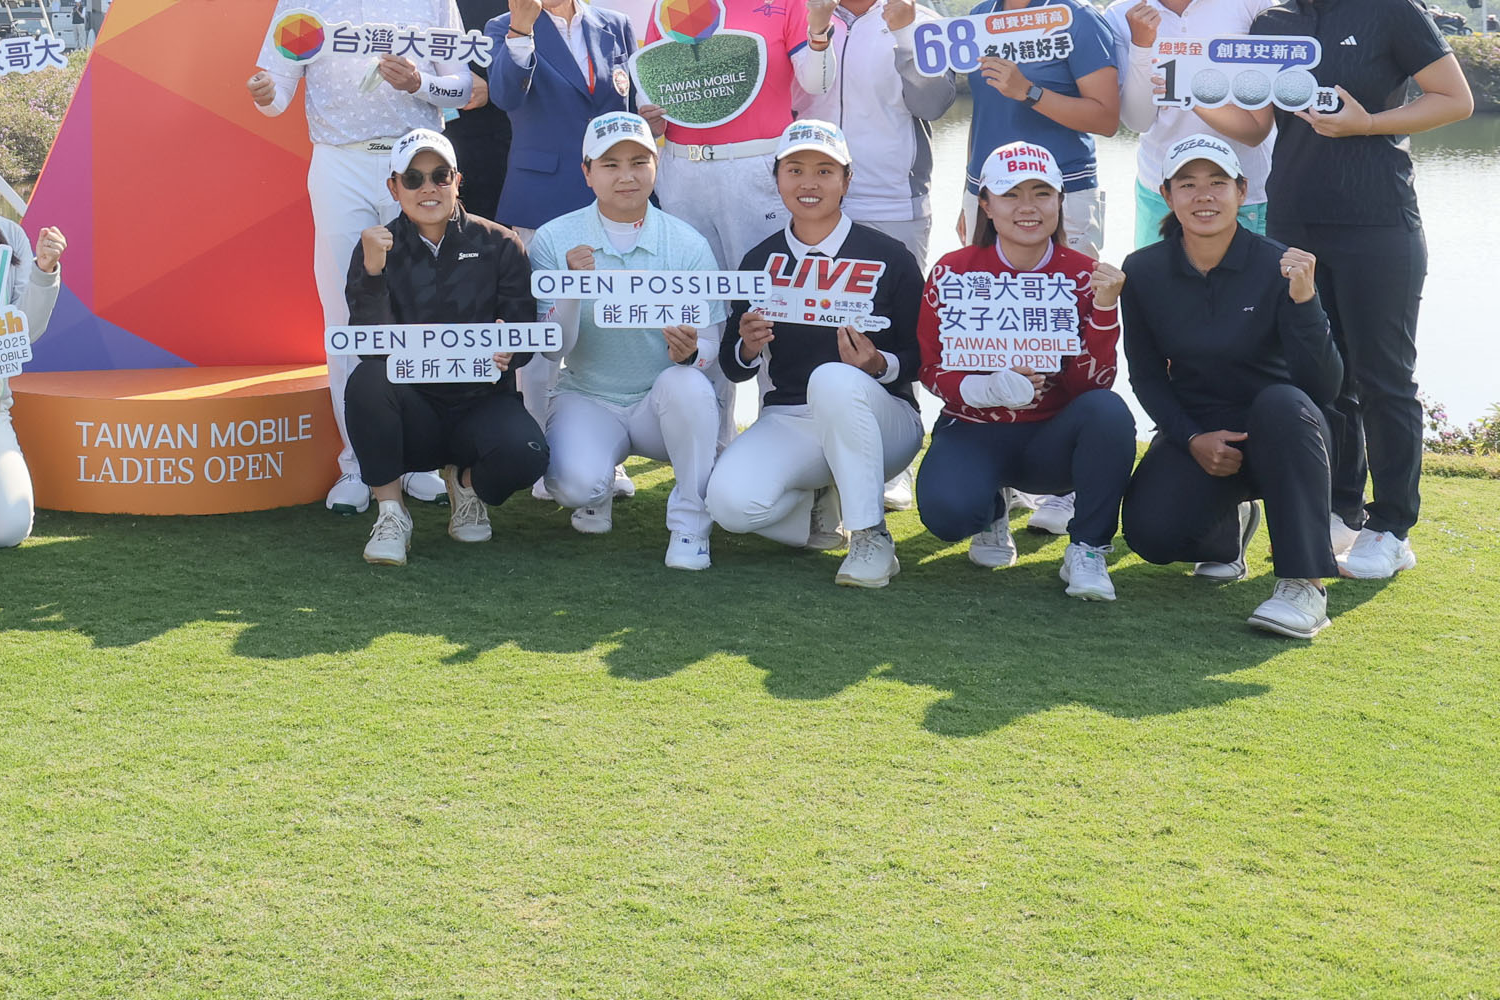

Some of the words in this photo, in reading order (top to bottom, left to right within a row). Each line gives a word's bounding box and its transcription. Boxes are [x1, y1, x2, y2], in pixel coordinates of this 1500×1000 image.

[991, 11, 1064, 30] 創賽史新高
[333, 26, 488, 63] 台灣大哥大
[914, 18, 981, 74] 68
[1158, 42, 1203, 56] 總獎金
[1216, 43, 1308, 60] 創賽史新高
[658, 80, 701, 94] TAIWAN
[704, 72, 747, 87] MOBILE
[660, 89, 702, 105] LADIES
[703, 85, 735, 99] OPEN
[1316, 91, 1334, 107] 萬
[997, 146, 1050, 161] Taishin
[1170, 141, 1230, 160] Titleist
[1007, 160, 1047, 174] Bank
[537, 275, 613, 294] OPEN
[631, 275, 767, 294] POSSIBLE
[770, 255, 882, 294] LIVE
[941, 275, 1074, 301] 台灣大哥大
[603, 304, 701, 324] 能所不能
[819, 314, 846, 324] AGLF
[942, 306, 1076, 333] 女子公開賽
[331, 330, 406, 350] OPEN
[423, 328, 557, 349] POSSIBLE
[944, 337, 1008, 351] TAIWAN
[1014, 338, 1077, 352] MOBILE
[396, 357, 493, 379] 能所不能
[945, 353, 1007, 368] LADIES
[1011, 354, 1058, 369] OPEN
[75, 421, 198, 449] TAIWAN
[210, 413, 312, 448] MOBILE
[76, 455, 195, 485] LADIES
[203, 451, 284, 484] OPEN
